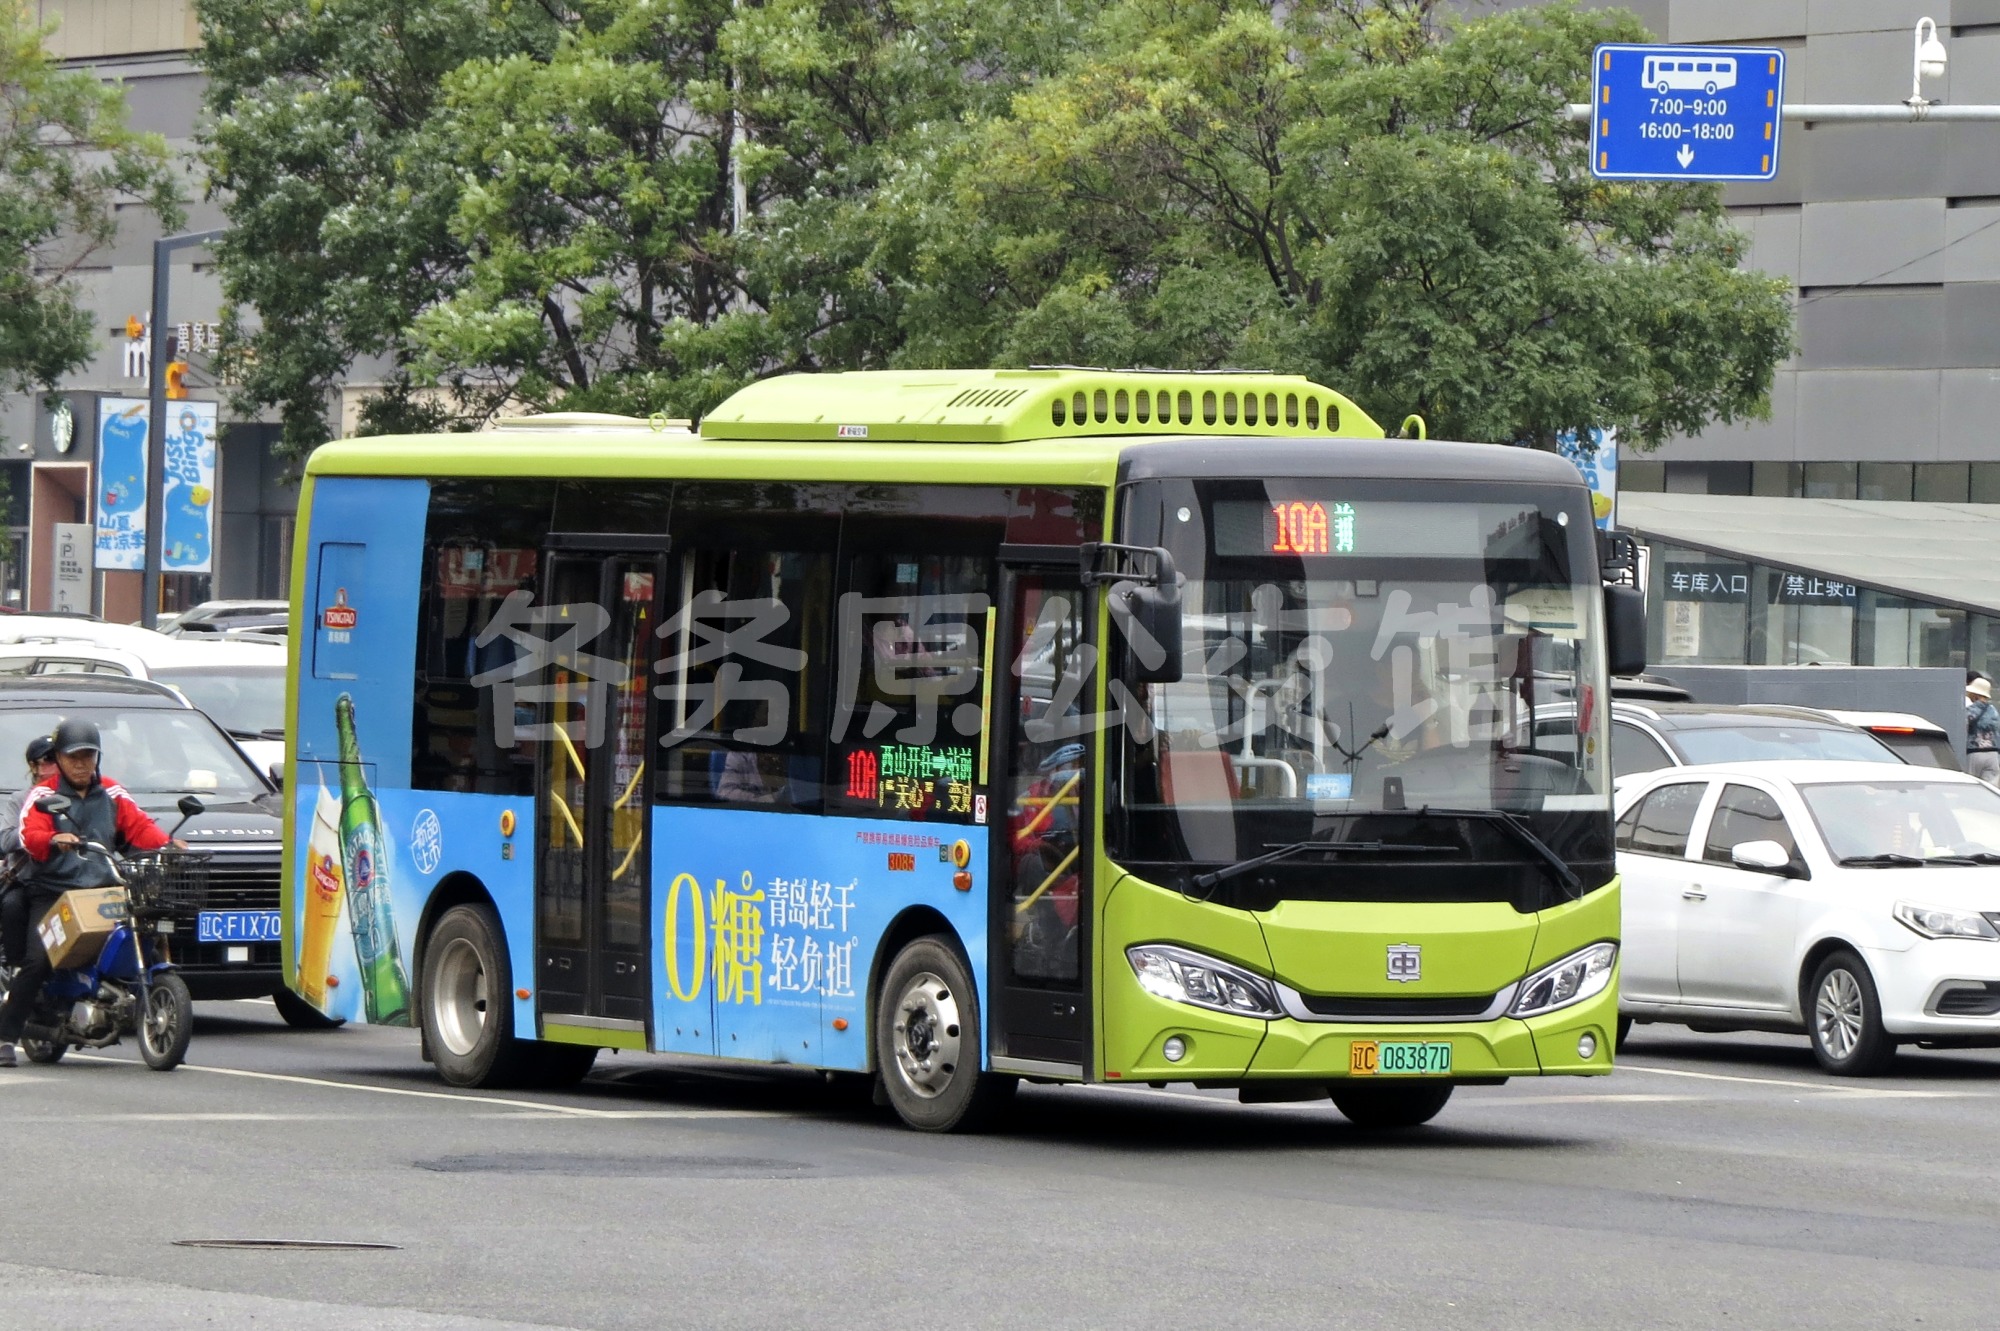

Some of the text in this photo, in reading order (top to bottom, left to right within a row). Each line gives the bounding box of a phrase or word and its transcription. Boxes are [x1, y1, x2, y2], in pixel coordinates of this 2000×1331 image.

[1650, 98, 1727, 116] 7:00-9:00
[1639, 122, 1734, 140] 16:00-18:00
[180, 431, 205, 483] Bing
[1272, 502, 1328, 552] 10A
[1671, 571, 1747, 594] 车库入口
[847, 750, 877, 800] 10A
[889, 853, 914, 871] 3085
[768, 933, 858, 997] 轻负担
